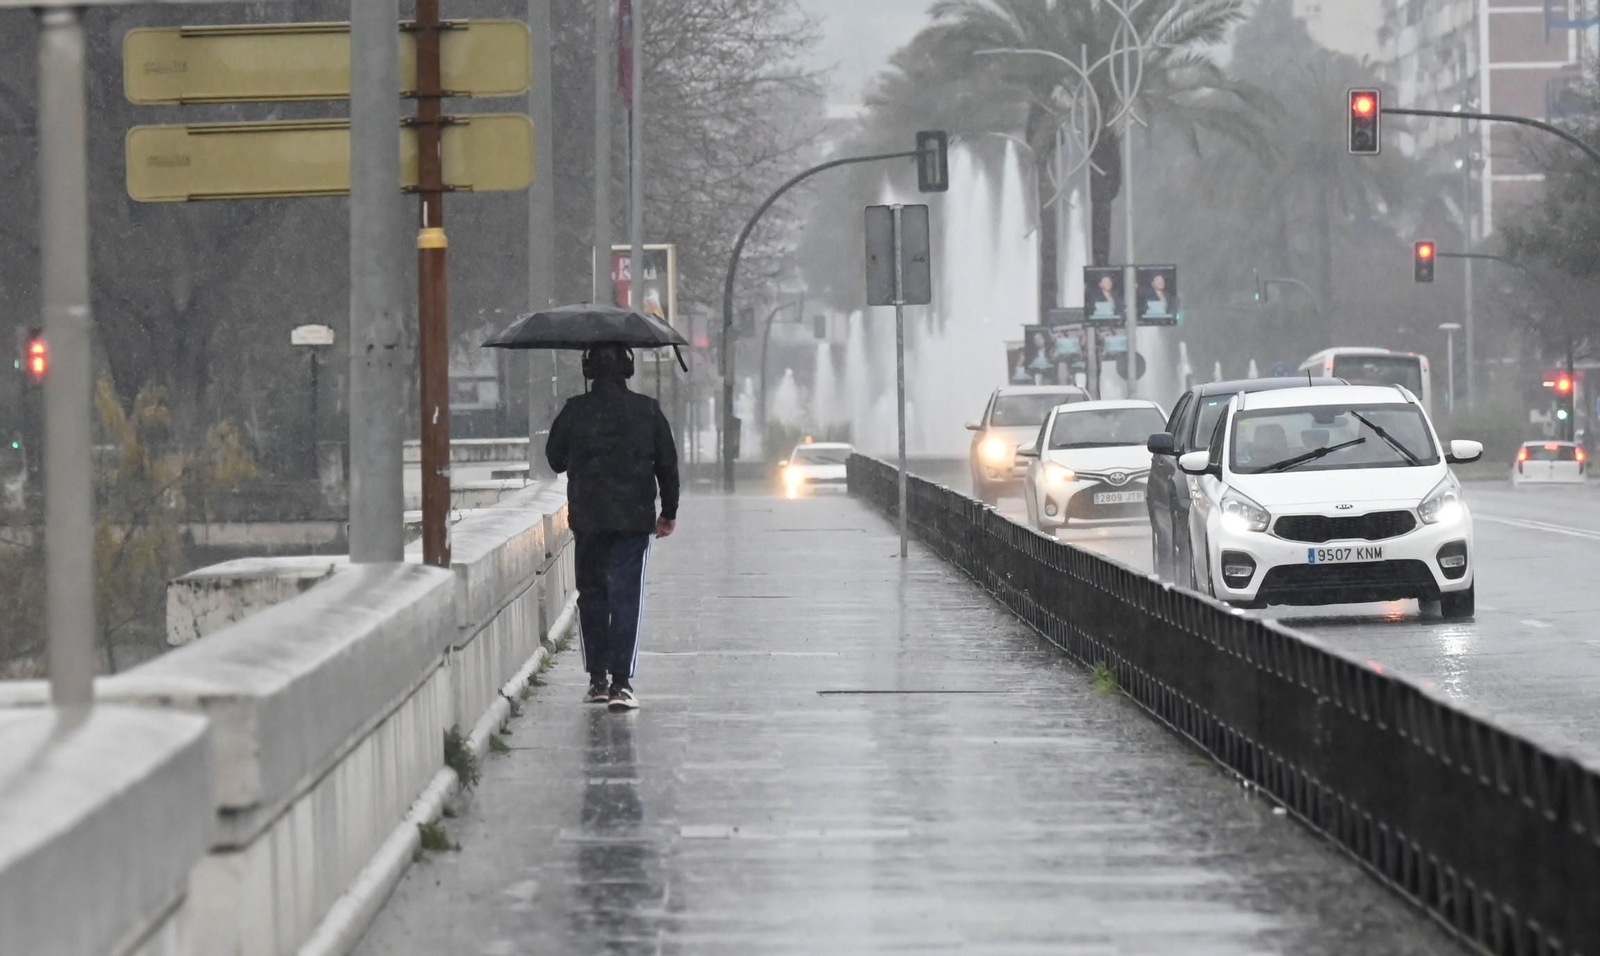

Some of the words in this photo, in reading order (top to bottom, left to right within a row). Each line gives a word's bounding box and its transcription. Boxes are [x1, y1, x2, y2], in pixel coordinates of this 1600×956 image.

[1100, 492, 1123, 503] 2809
[1317, 548, 1352, 562] 9507
[1356, 546, 1383, 560] KNM
